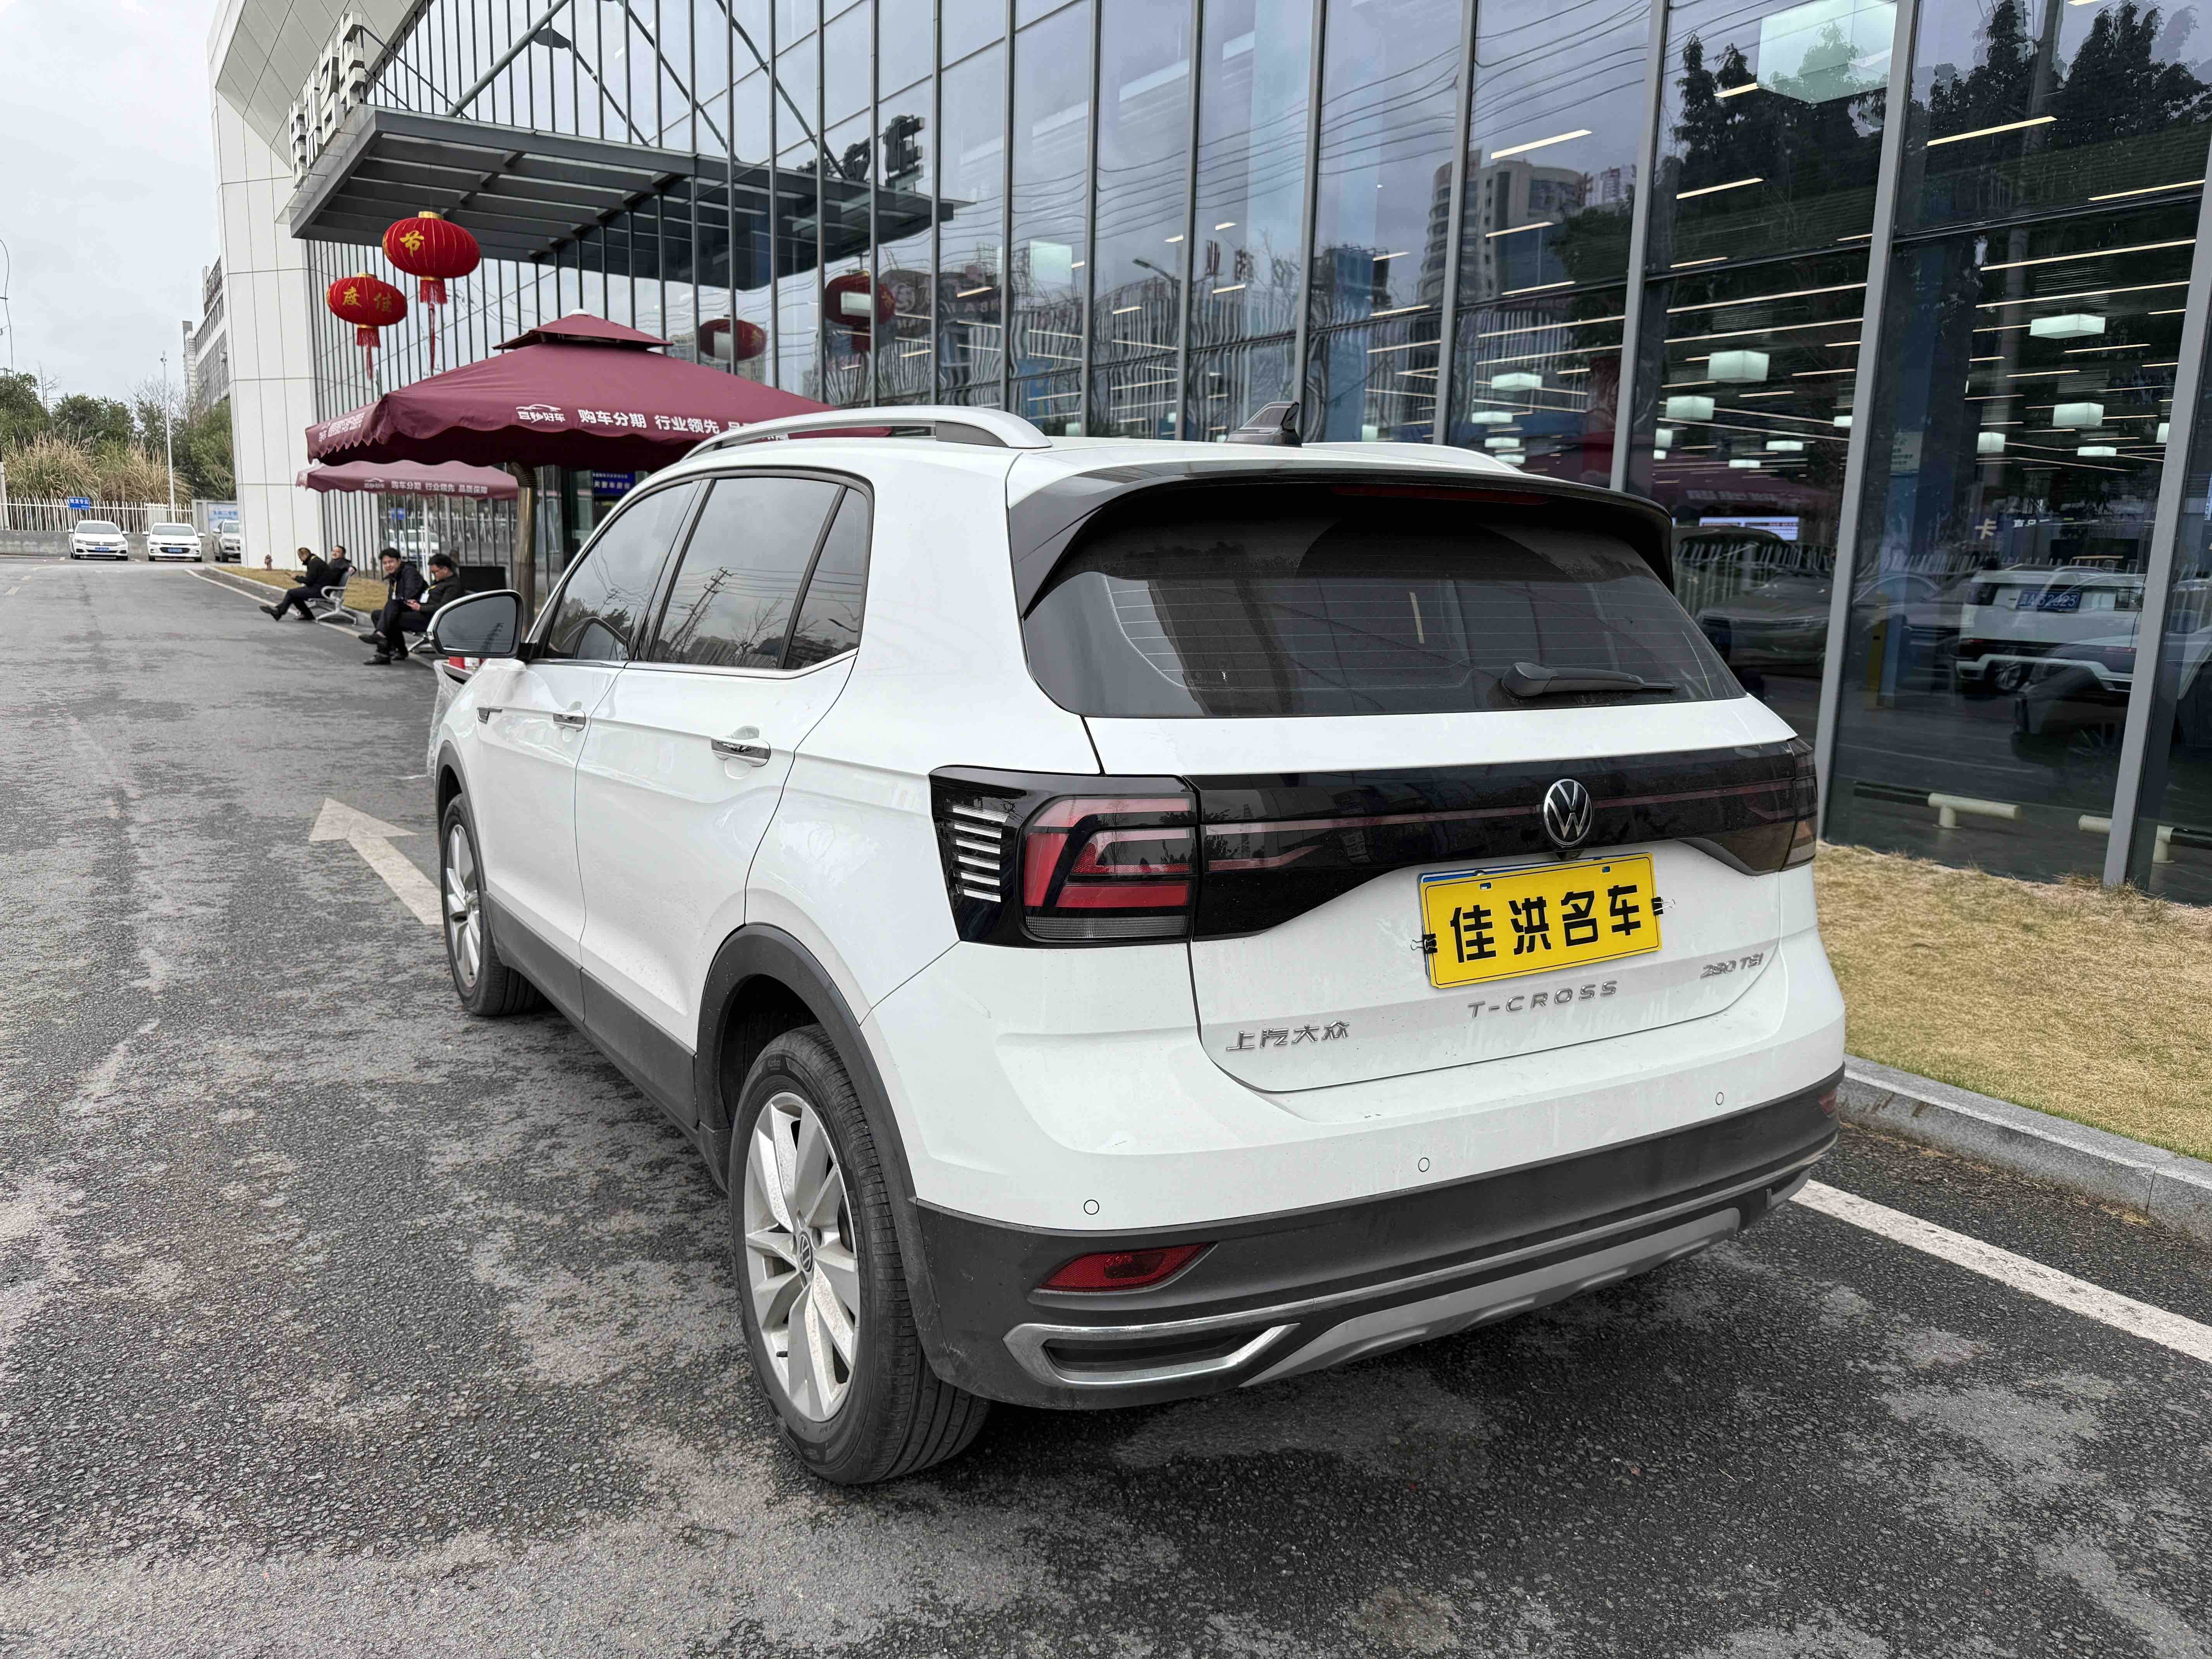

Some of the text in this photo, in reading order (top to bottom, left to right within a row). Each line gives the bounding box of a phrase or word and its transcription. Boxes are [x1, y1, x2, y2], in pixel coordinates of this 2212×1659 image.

[400, 230, 425, 257] 节
[578, 409, 647, 428] 购车分期
[654, 415, 720, 434] 行业领先
[391, 481, 421, 490] 购车分期
[425, 483, 455, 492] 行业领先
[459, 484, 488, 494] 品质保障
[1450, 884, 1641, 963] 佳洪名车
[1700, 953, 1764, 979] 280 TSI
[1467, 981, 1617, 1018] T-CROSS
[1225, 1020, 1350, 1051] 上汽大众
